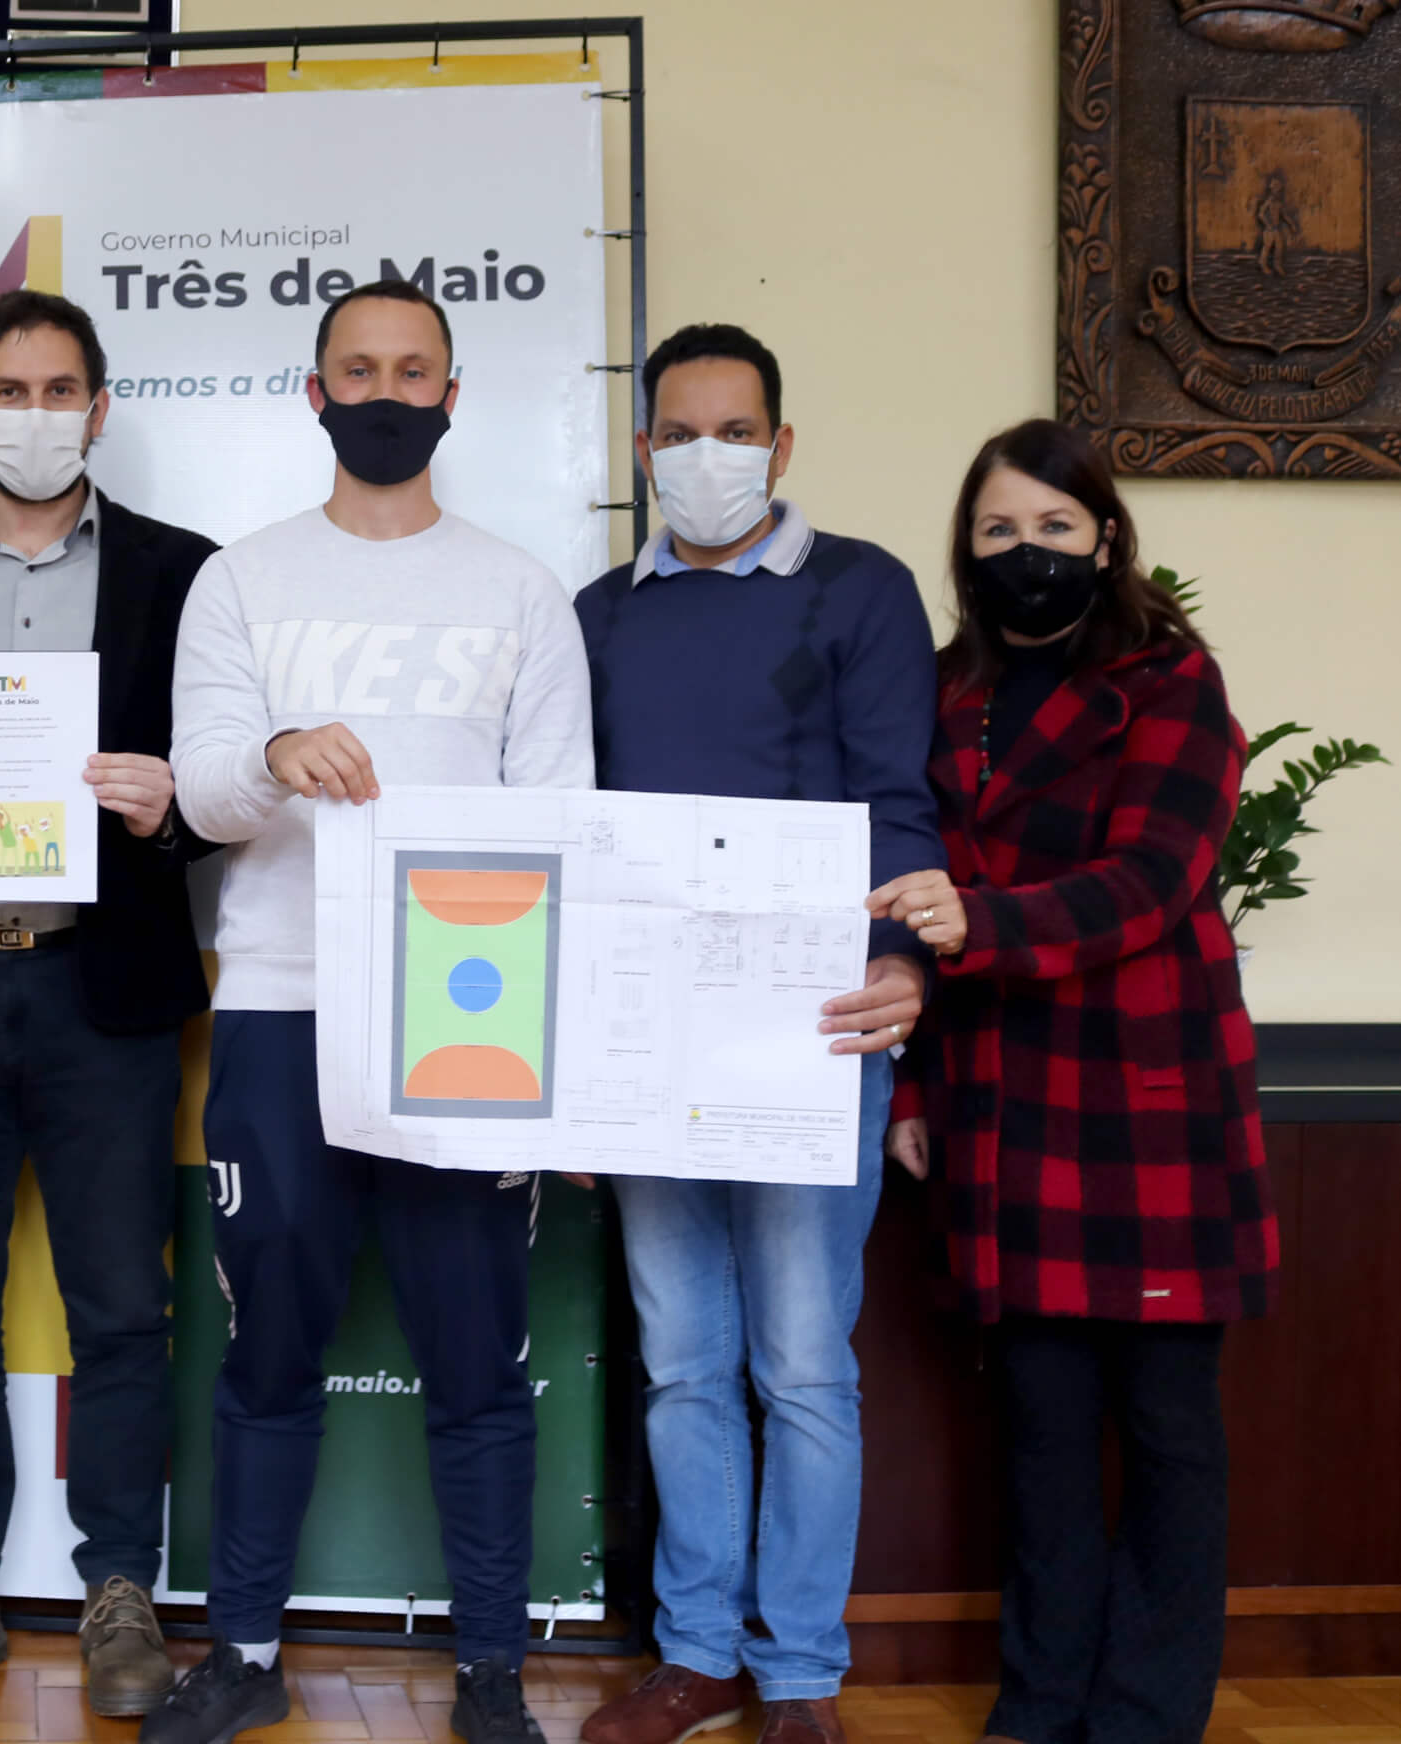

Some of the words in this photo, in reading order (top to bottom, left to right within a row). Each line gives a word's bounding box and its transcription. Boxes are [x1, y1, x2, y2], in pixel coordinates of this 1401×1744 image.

[102, 231, 212, 251] Governo
[221, 224, 351, 250] Municipal
[102, 259, 248, 310] Três
[270, 257, 355, 306] de
[380, 248, 546, 302] Maio
[230, 374, 253, 395] a
